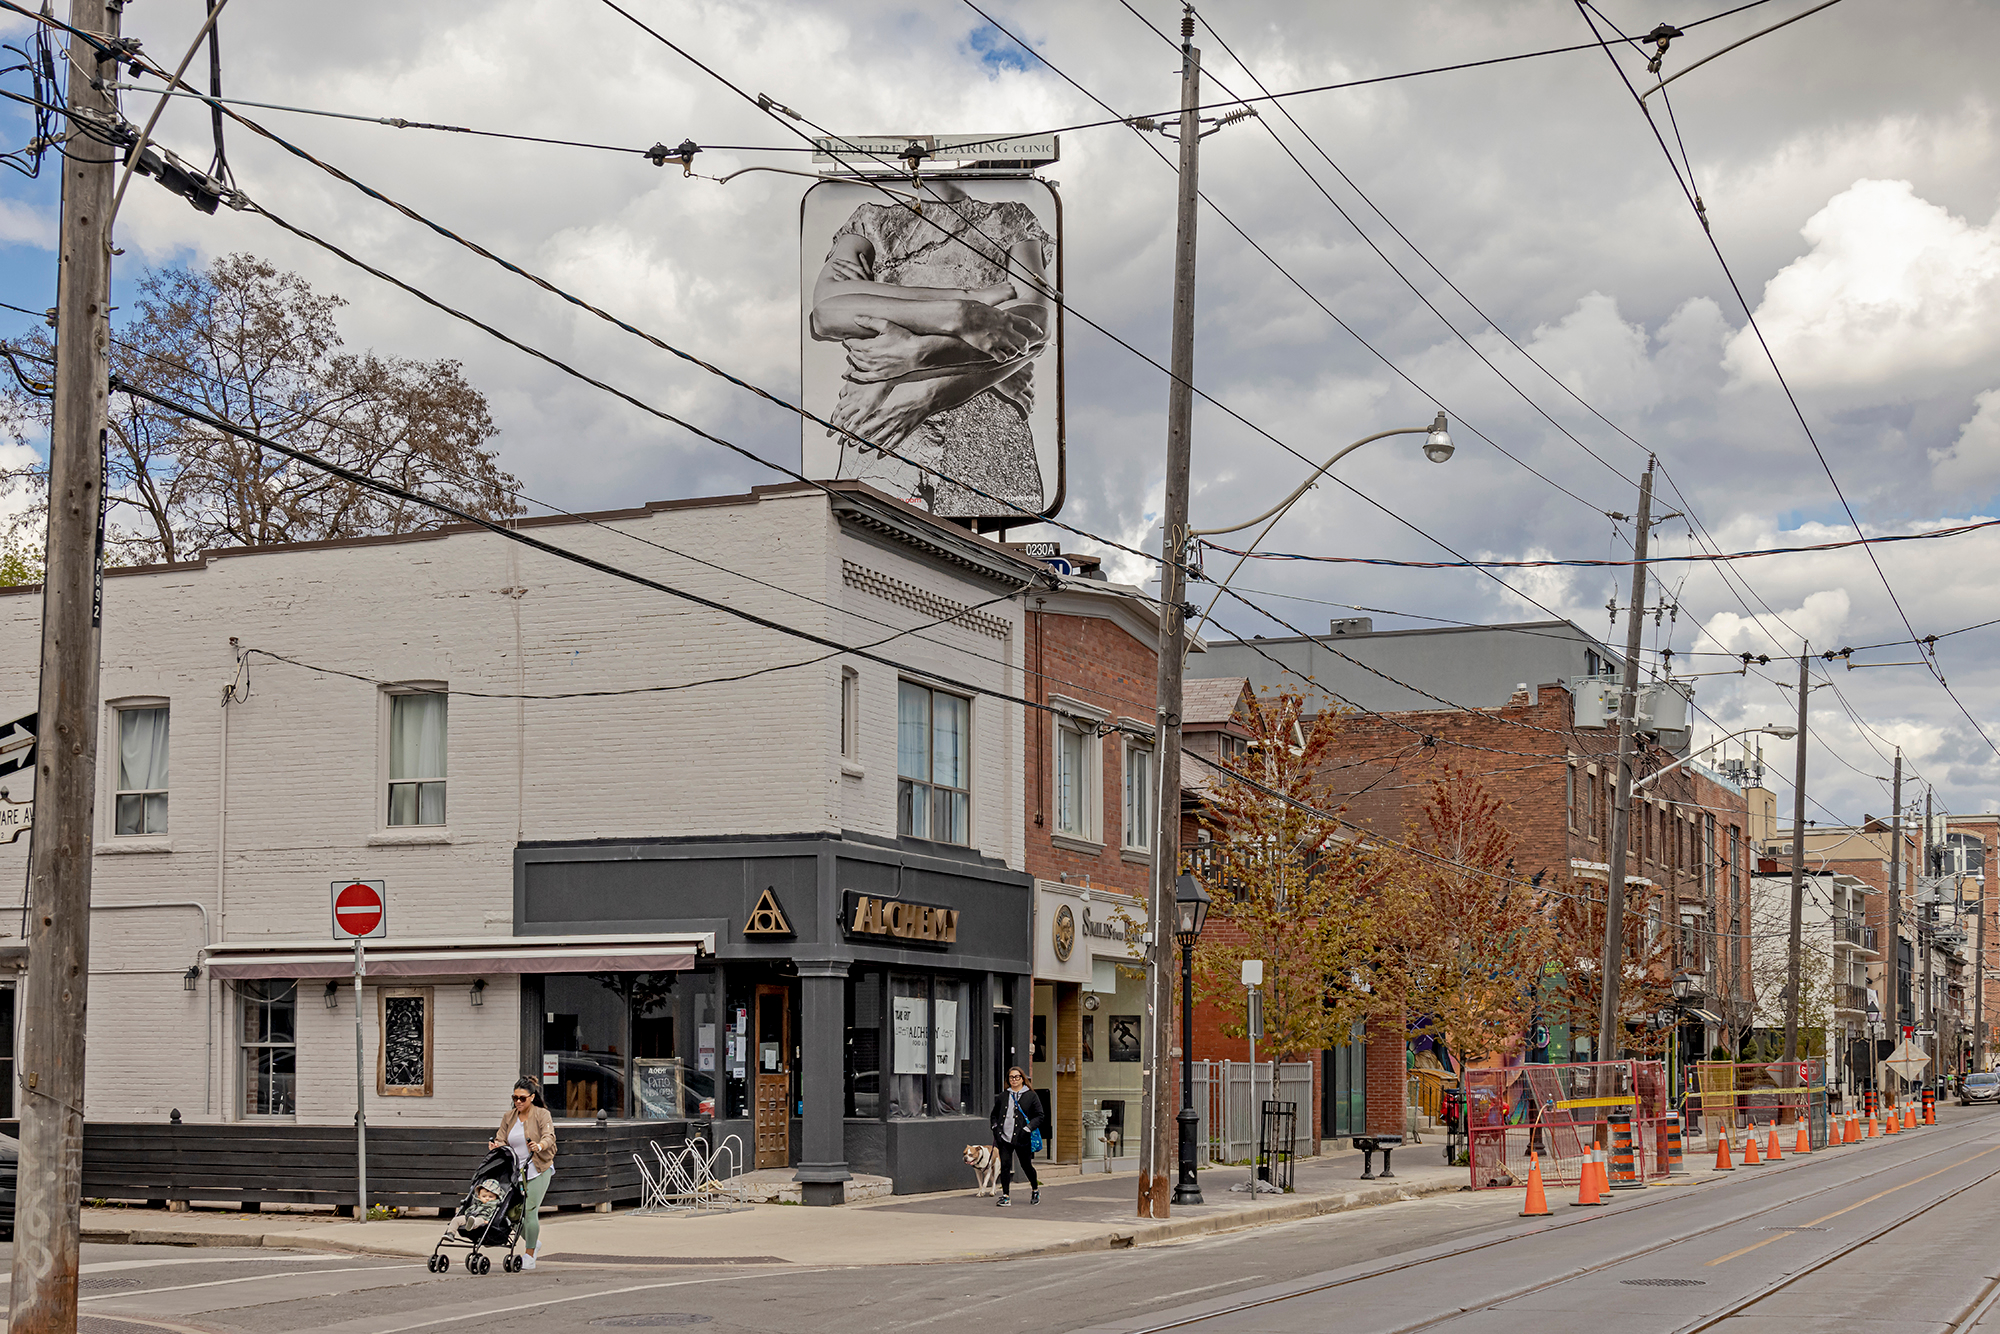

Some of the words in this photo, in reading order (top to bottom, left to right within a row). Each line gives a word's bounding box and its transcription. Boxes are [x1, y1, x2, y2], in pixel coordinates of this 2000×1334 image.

[814, 138, 901, 157] DENTURE
[1013, 144, 1054, 154] CLINIC
[1025, 543, 1055, 556] 0230A
[92, 557, 102, 619] P892
[0, 808, 19, 826] ARE
[852, 896, 960, 943] ALCHEMY
[908, 1026, 941, 1039] ALCHEY
[1801, 1066, 1818, 1075] SOP
[648, 1076, 671, 1088] PATIO
